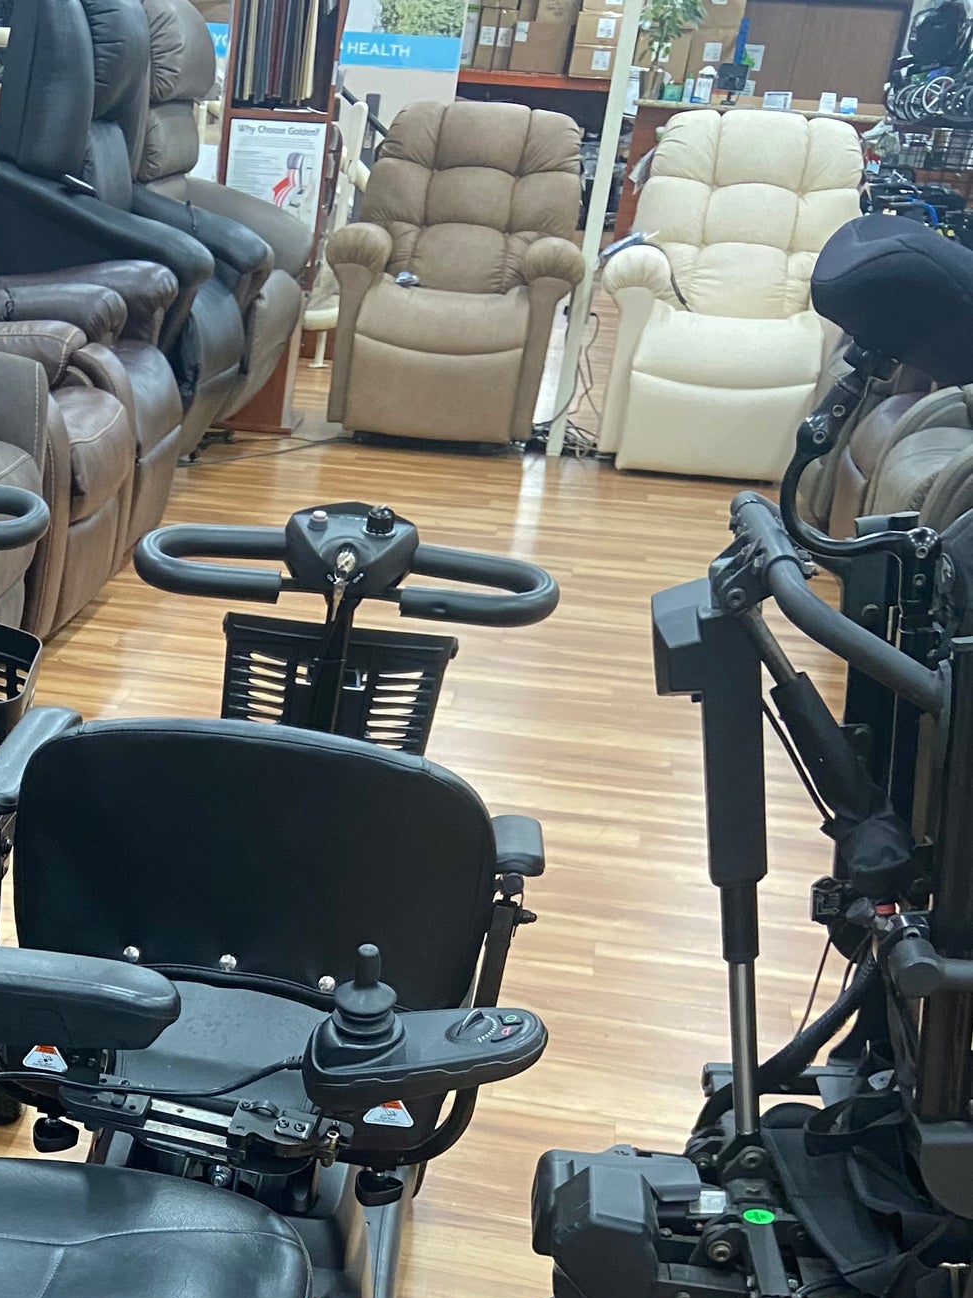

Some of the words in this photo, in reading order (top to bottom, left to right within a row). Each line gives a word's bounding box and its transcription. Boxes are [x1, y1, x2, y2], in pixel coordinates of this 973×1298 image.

[347, 41, 411, 58] HEALTH
[237, 124, 256, 135] Why
[257, 125, 286, 134] Choose
[288, 126, 320, 136] Golden?
